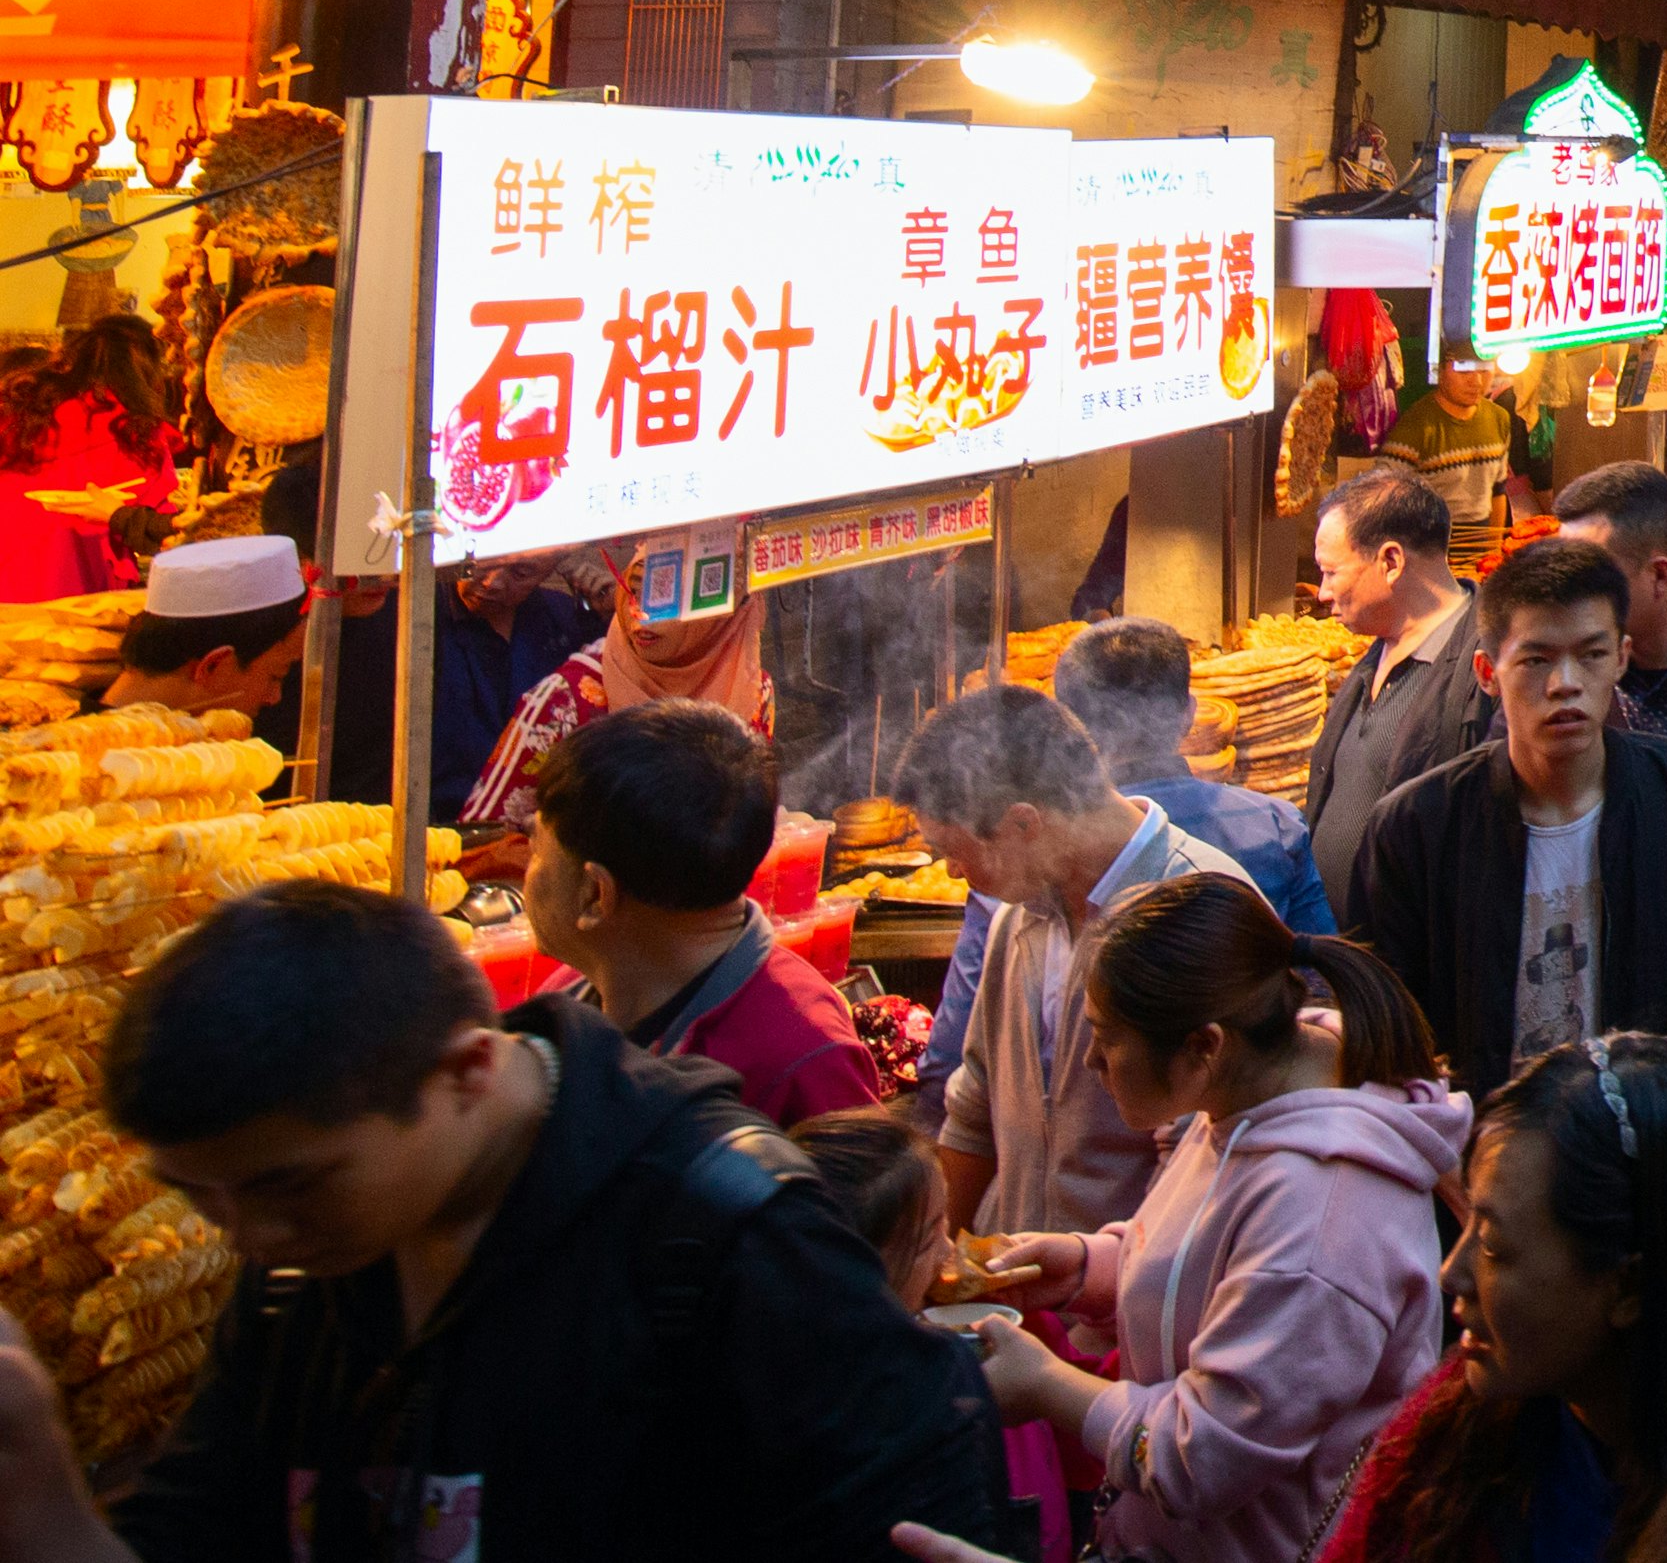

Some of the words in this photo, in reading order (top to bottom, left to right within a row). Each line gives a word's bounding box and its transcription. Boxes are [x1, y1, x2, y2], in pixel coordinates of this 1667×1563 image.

[490, 157, 657, 259] 鲜榨
[901, 205, 1020, 289] 章鱼
[1481, 198, 1664, 333] 香辣烤面筋
[860, 297, 1048, 412] 小丸子
[1065, 230, 1256, 370] 疆营养馕
[461, 280, 815, 466] 石榴汁
[752, 529, 804, 574] 番茄味
[810, 521, 861, 560] 沙拉味
[869, 507, 918, 549] 青芥味
[925, 497, 991, 539] 黑胡椒味
